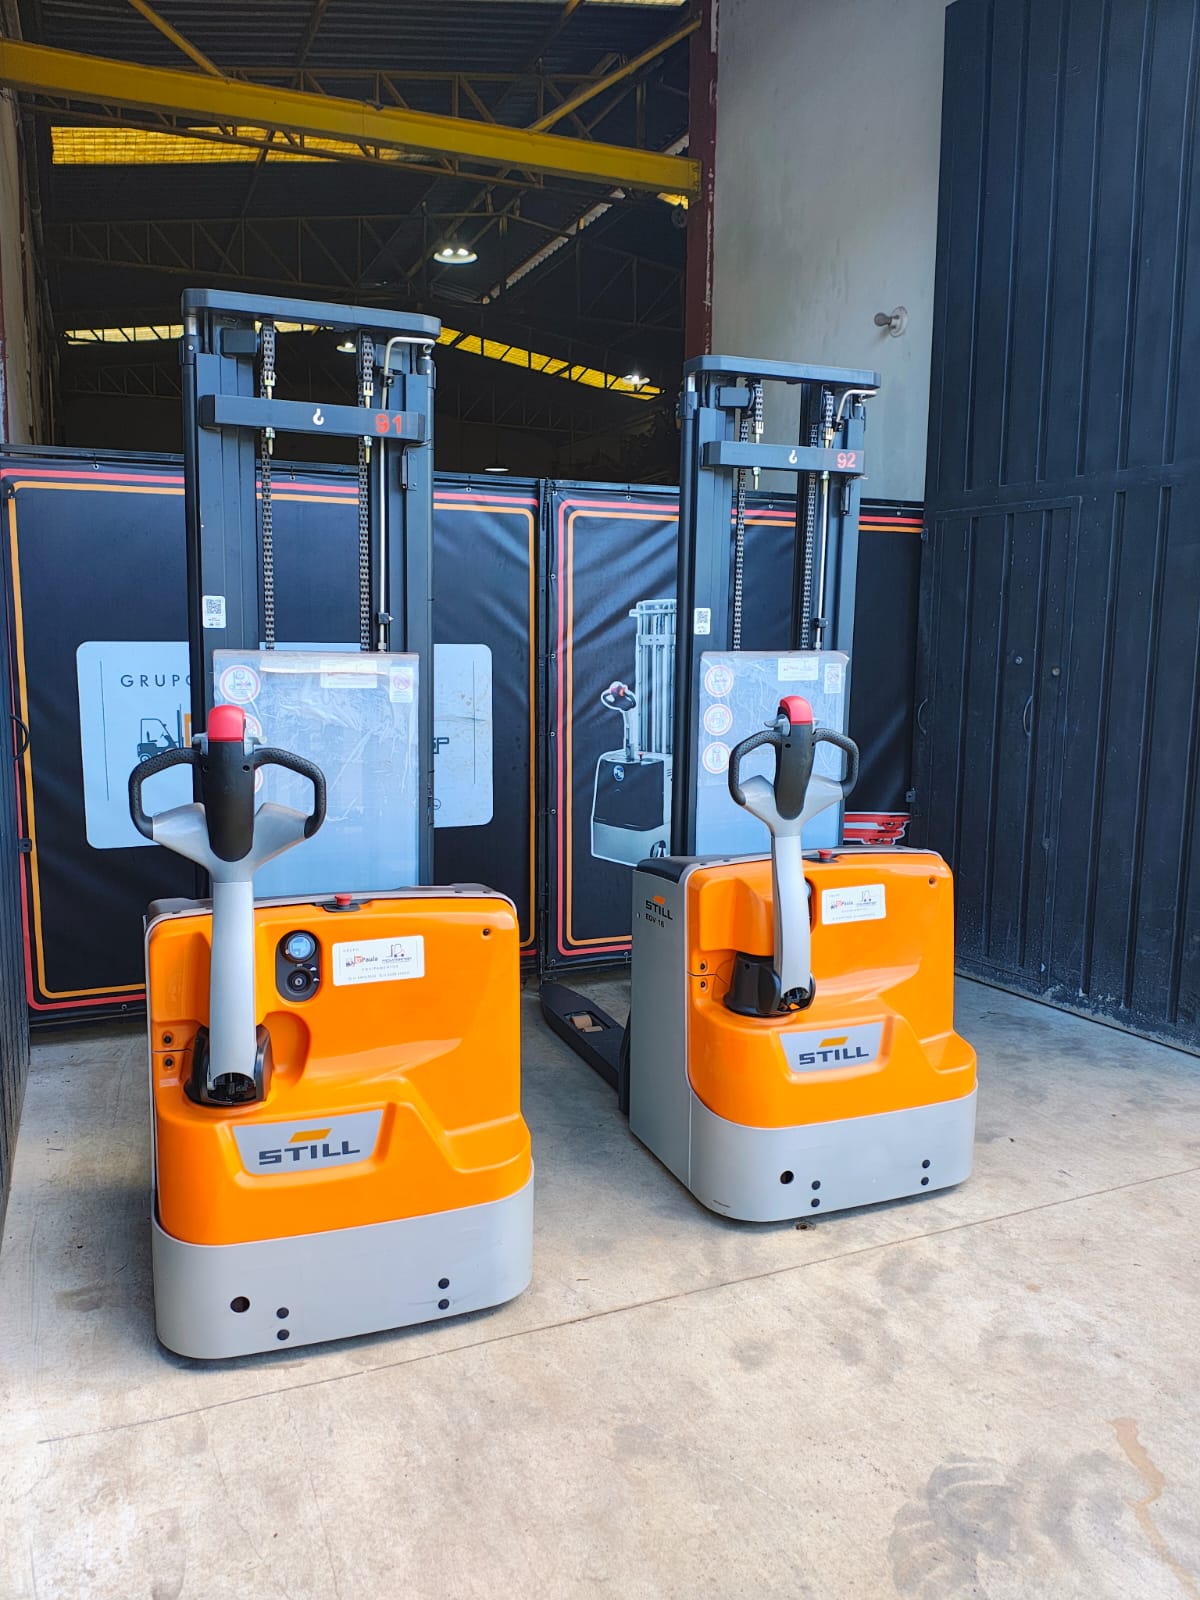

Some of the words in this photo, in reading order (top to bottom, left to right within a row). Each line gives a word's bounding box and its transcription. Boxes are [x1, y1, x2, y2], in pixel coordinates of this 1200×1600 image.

[375, 413, 402, 434] 91
[836, 452, 857, 469] 92
[645, 899, 673, 921] STILL
[798, 1046, 870, 1066] STILL
[258, 1140, 361, 1166] STILL
